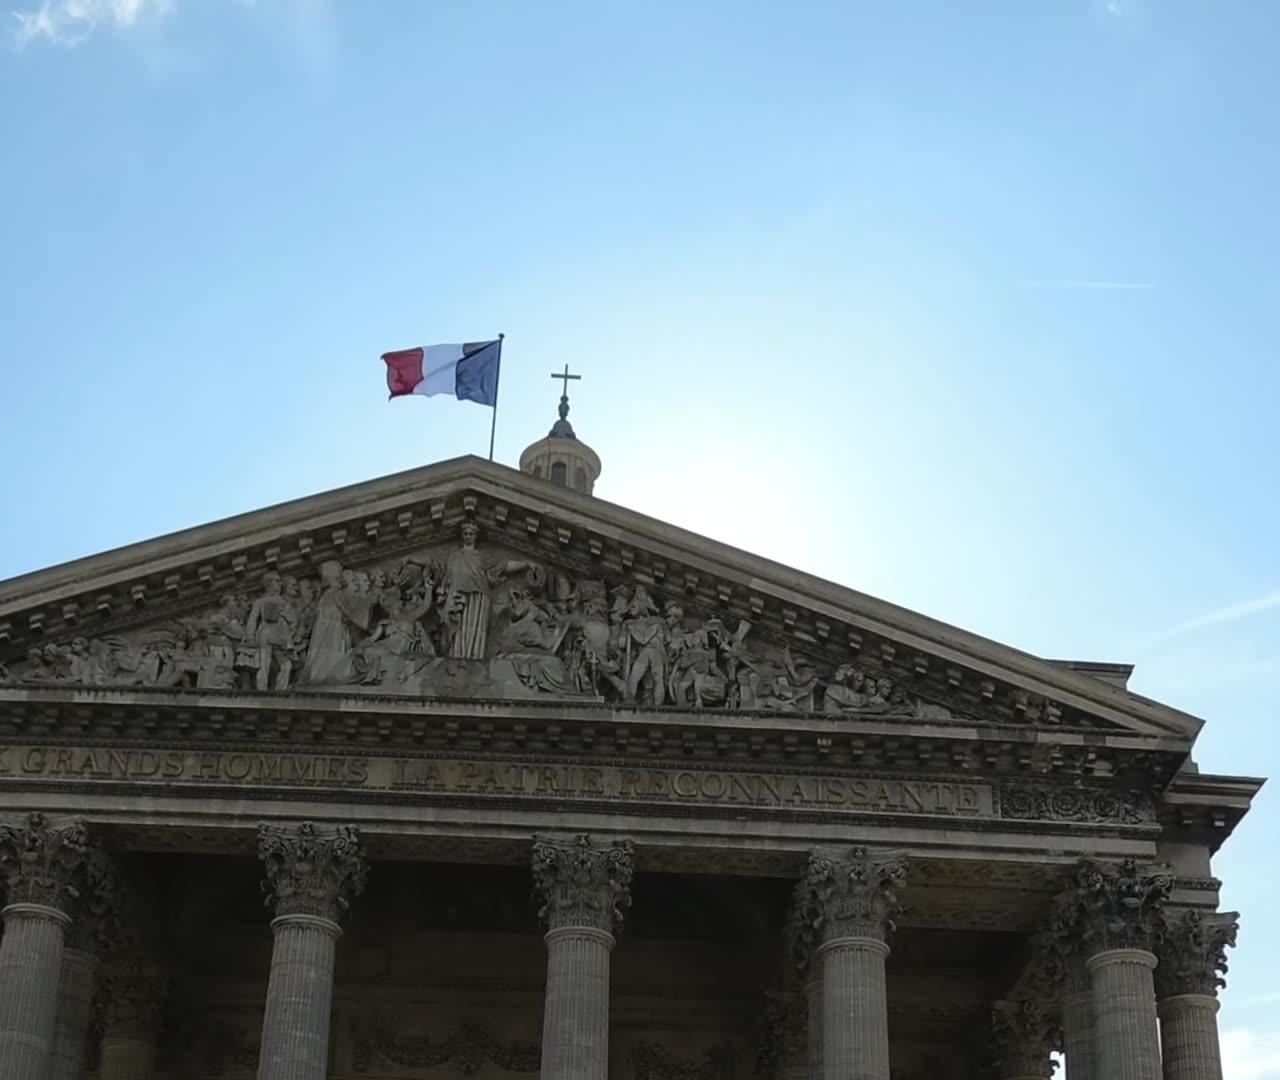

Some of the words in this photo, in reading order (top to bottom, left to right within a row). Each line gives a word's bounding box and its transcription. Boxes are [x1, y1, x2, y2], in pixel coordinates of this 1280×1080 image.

[21, 748, 185, 778] GRANDS
[191, 752, 369, 785] HOMMES
[391, 758, 448, 788] LA
[456, 761, 604, 794] PATRIE
[618, 769, 980, 813] RECONNAISSANTE
